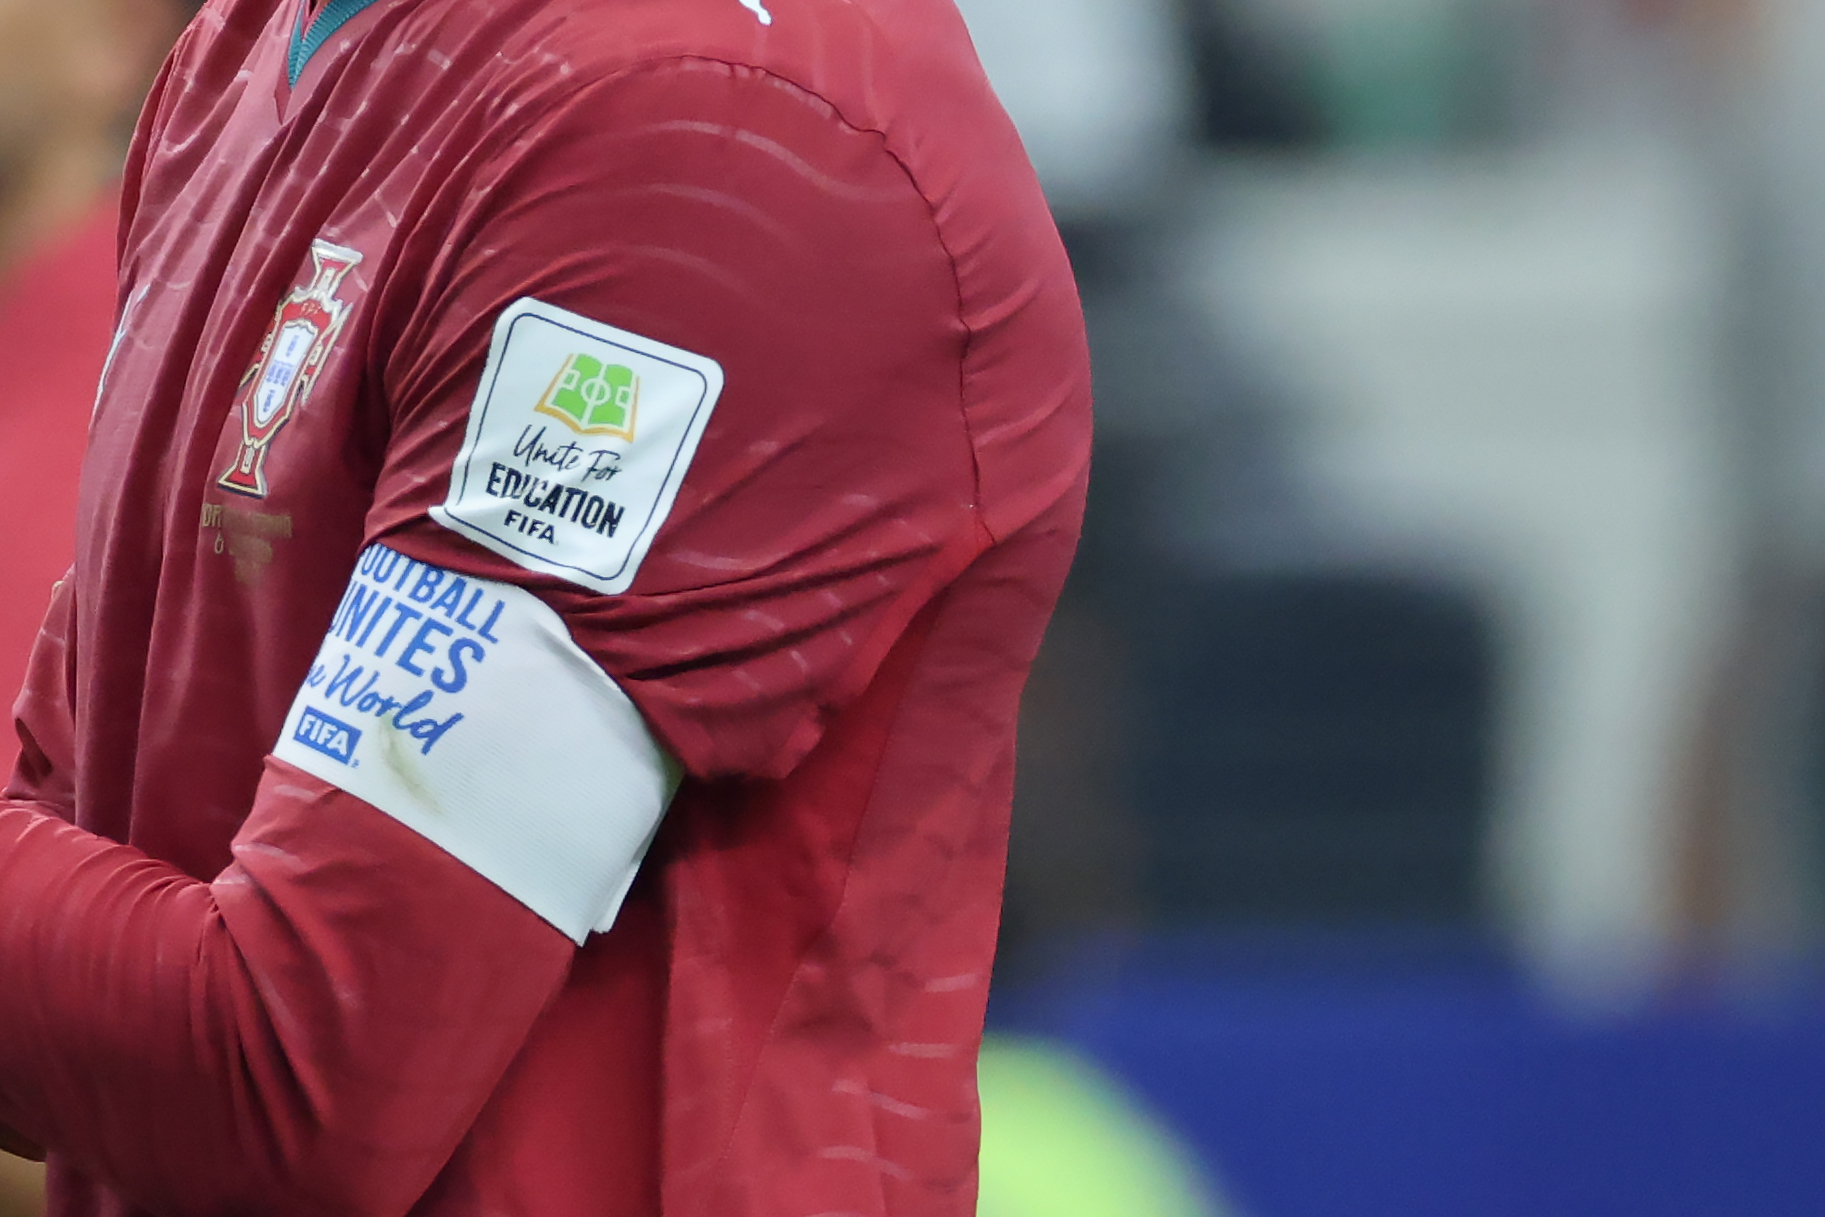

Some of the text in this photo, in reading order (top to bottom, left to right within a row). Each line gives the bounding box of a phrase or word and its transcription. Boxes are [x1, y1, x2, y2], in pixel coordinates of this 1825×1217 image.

[513, 424, 622, 482] Unite For
[486, 462, 625, 538] EDUCATION
[504, 510, 556, 545] FIFA
[360, 544, 505, 644] OOTBALL
[298, 713, 350, 757] FIFA
[325, 654, 464, 755] World
